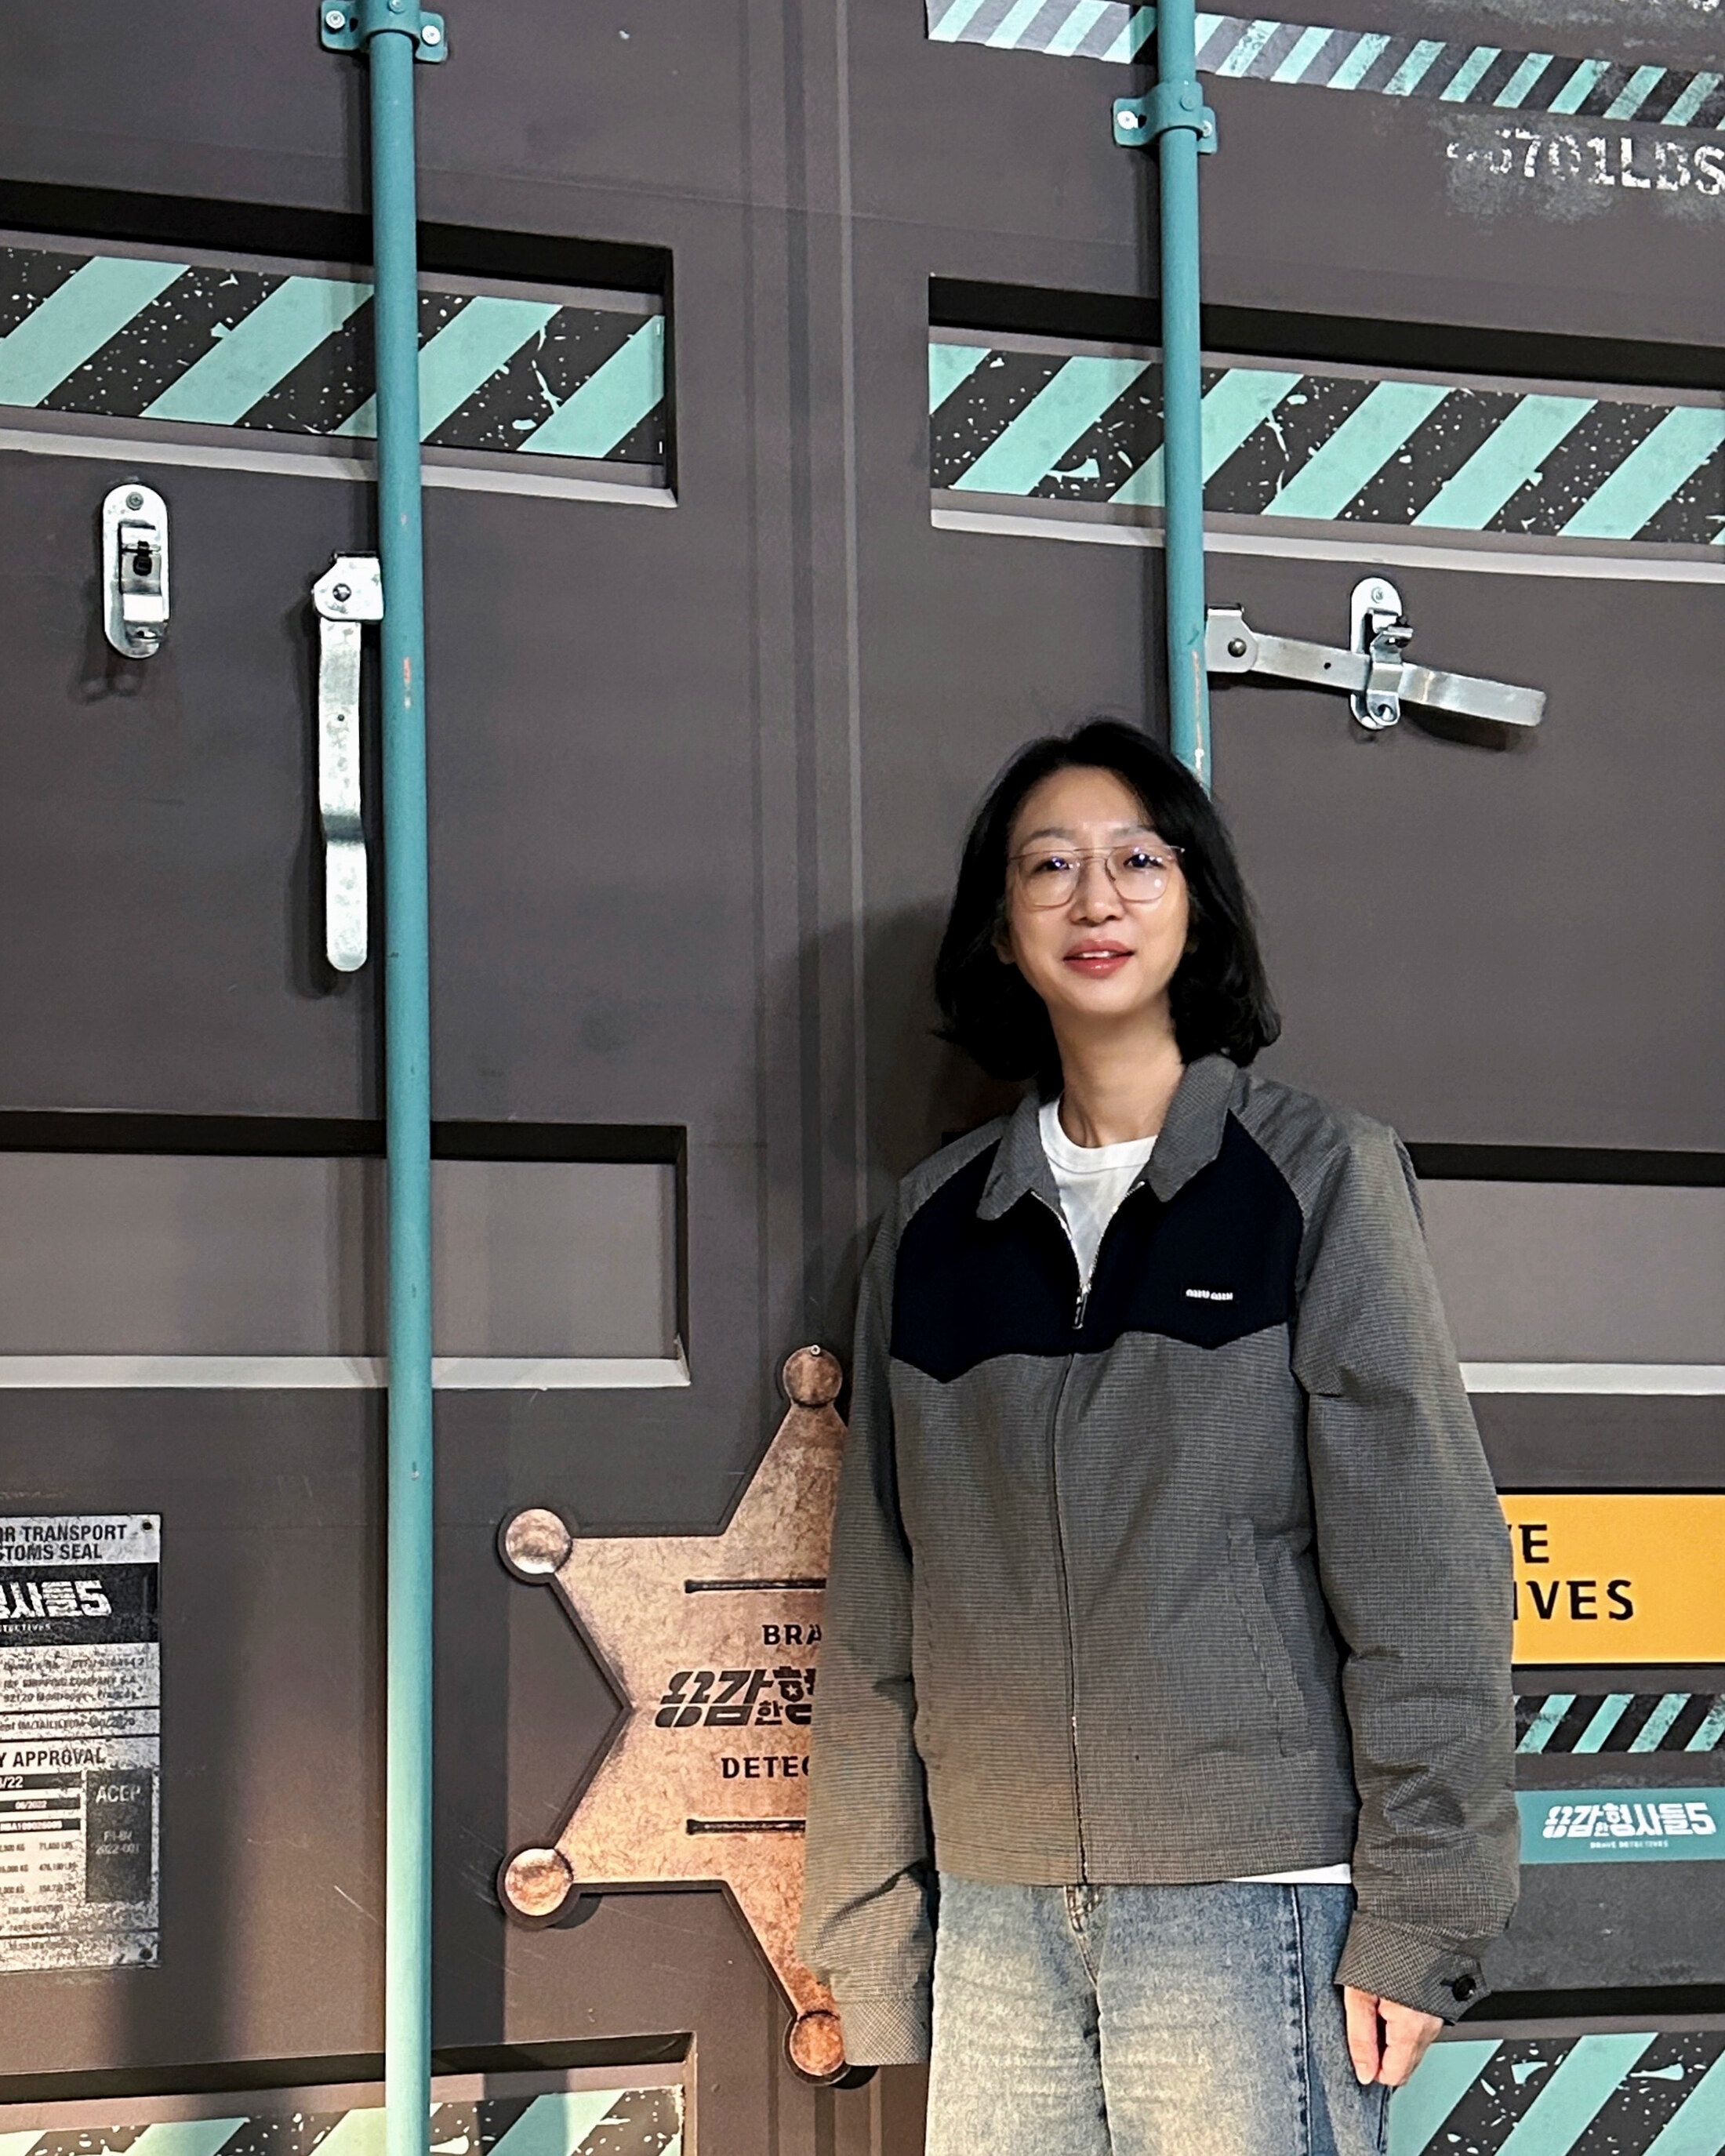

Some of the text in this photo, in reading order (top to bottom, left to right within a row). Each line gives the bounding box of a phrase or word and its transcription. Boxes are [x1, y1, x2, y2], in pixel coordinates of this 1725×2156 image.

[0, 1524, 127, 1542] R TRANSPORT
[60, 1544, 102, 1559] SEAL
[1507, 1524, 1549, 1563] E
[13, 1747, 106, 1767] APPROVAL
